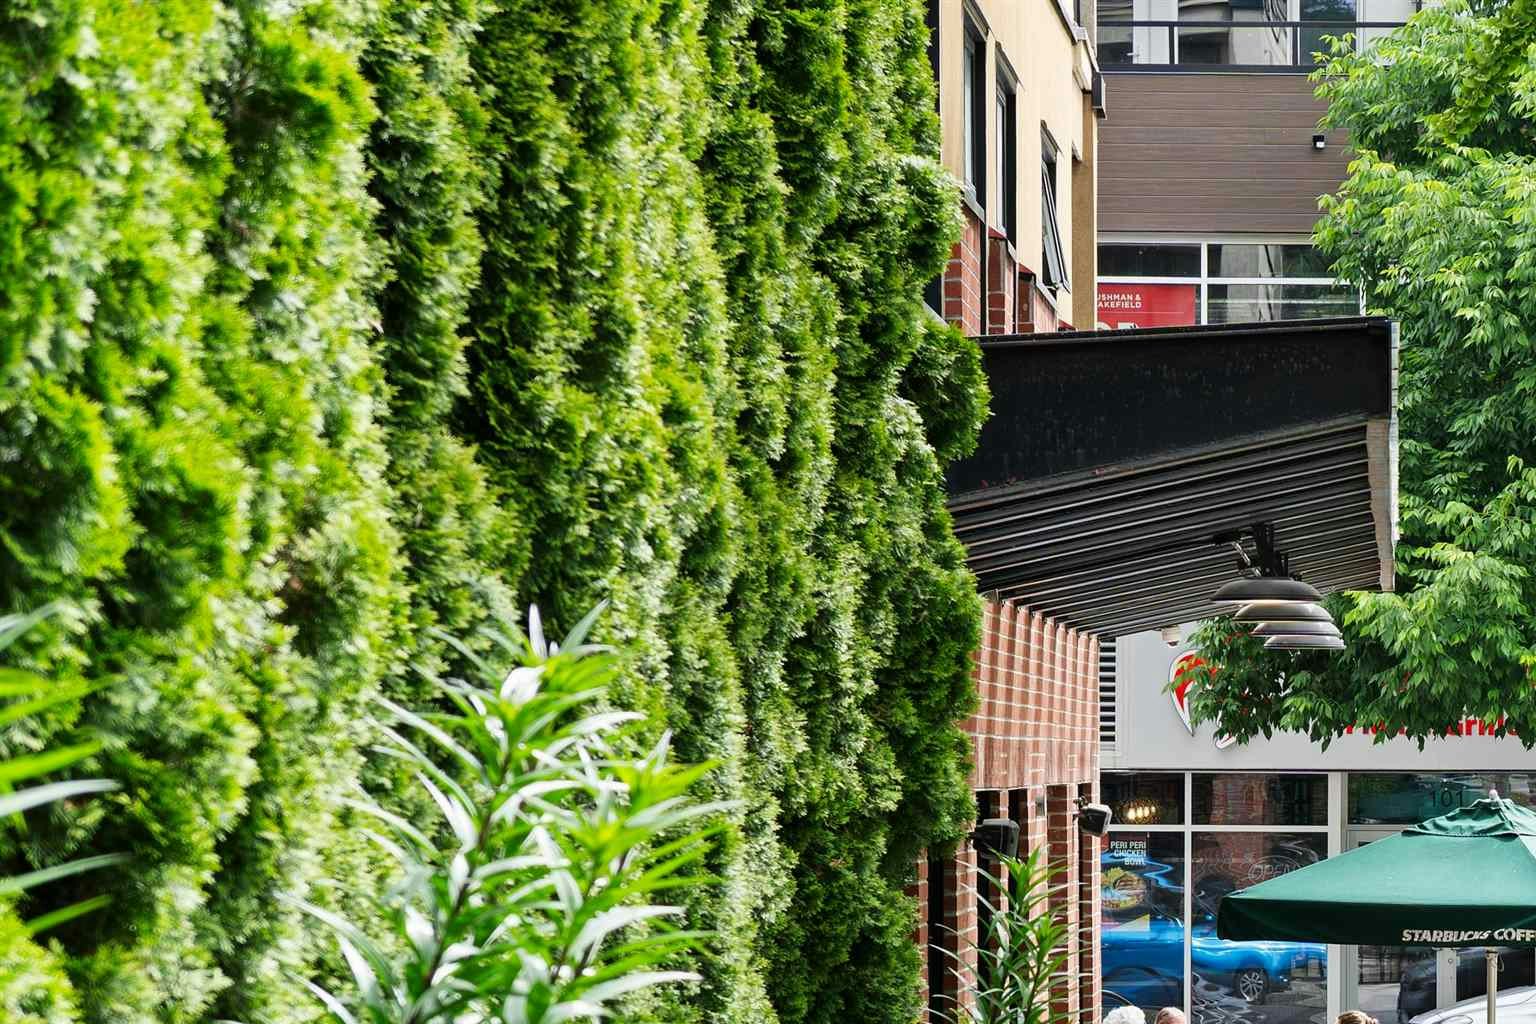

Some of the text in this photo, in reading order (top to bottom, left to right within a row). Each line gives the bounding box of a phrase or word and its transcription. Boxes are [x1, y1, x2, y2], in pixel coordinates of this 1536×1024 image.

[1135, 293, 1142, 301] &
[1429, 789, 1463, 808] 101
[1110, 841, 1147, 849] PERI PERI
[1114, 849, 1147, 857] CHICKEN
[1124, 857, 1146, 865] BOWL
[1401, 928, 1491, 942] STARBUCKS
